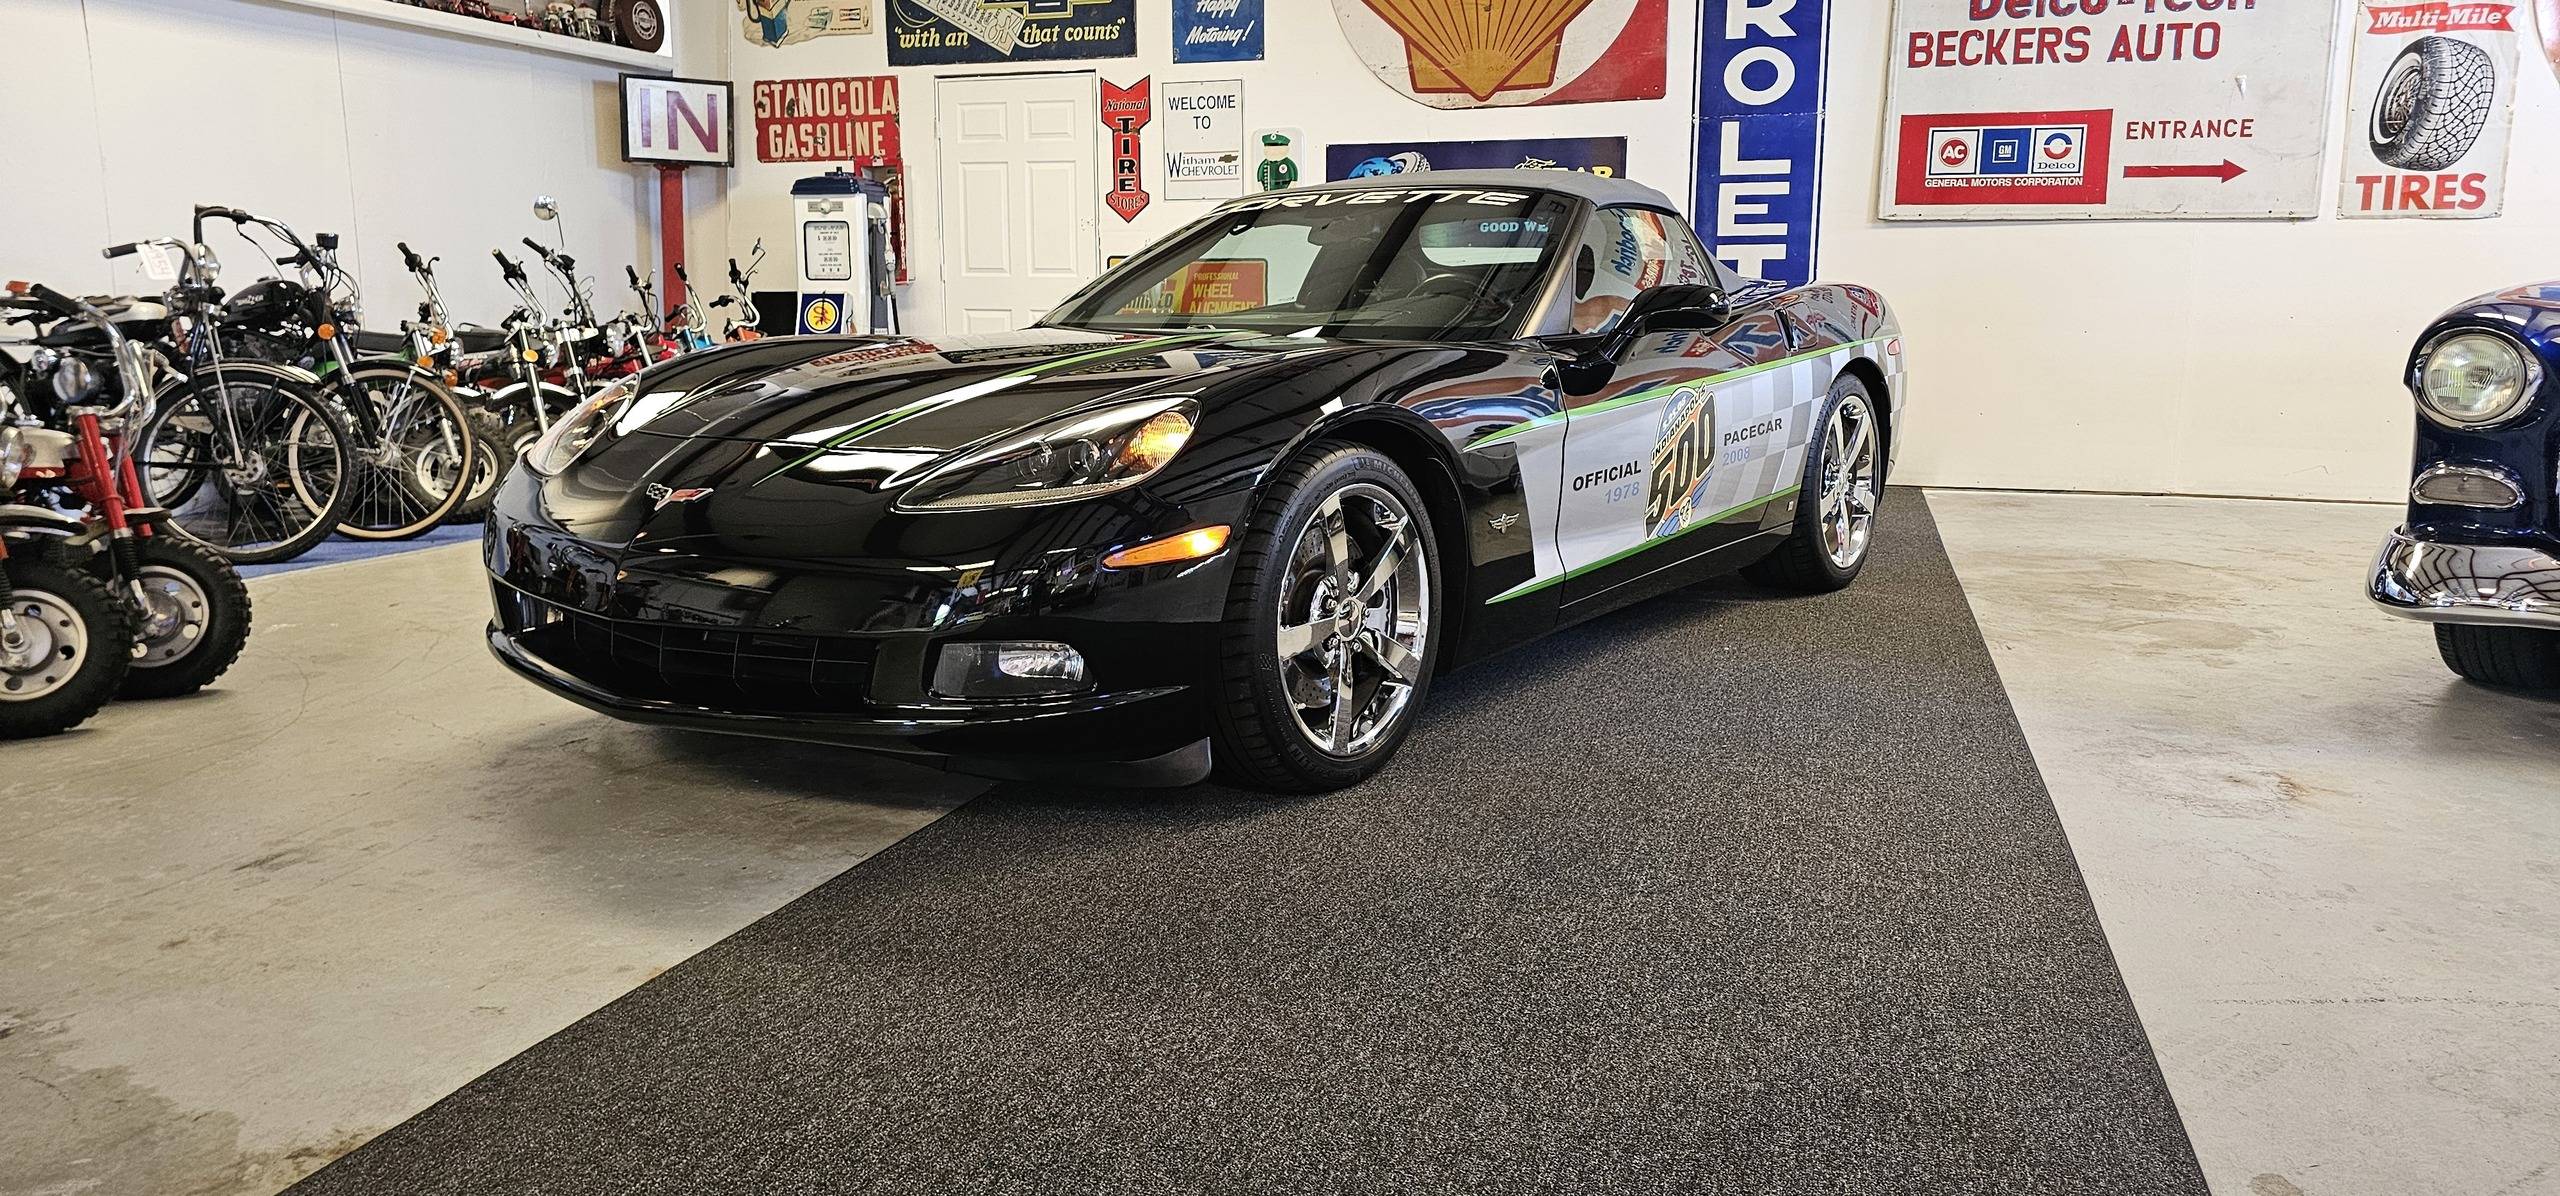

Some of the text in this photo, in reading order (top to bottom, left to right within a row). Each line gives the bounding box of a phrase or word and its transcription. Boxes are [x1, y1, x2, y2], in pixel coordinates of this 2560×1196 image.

[2375, 5, 2501, 29] Multi-Mile
[945, 32, 969, 47] an
[1023, 24, 1059, 43] that
[1185, 20, 1255, 47] Motoring!
[1907, 22, 2220, 68] BECKERS AUTO
[756, 79, 897, 119] STANOCOLA
[1104, 97, 1147, 112] National
[1168, 95, 1236, 111] WELCOME
[640, 88, 719, 153] IN
[1193, 115, 1211, 130] TO
[2126, 118, 2255, 140] ENTRANCE
[768, 121, 886, 159] GASOLINE
[1998, 144, 2012, 157] GM
[1116, 116, 1136, 193] TIRE
[1942, 145, 1966, 160] AC
[1166, 152, 1215, 178] Witham
[1182, 164, 1239, 177] CHEVROLET
[2037, 161, 2076, 171] Delco
[1925, 177, 2083, 188] GENERAL MOTORS CORPORATION
[2356, 173, 2487, 211] TIRES
[1110, 193, 1145, 211] STORES
[1480, 221, 1519, 233] GOOD
[1193, 282, 1234, 298] WHEEL
[1723, 417, 1783, 446] PACECAR
[1645, 394, 1715, 540] 500
[1722, 446, 1750, 466] 2008
[1572, 460, 1642, 491] OFFICIAL
[1605, 481, 1640, 504] 1978
